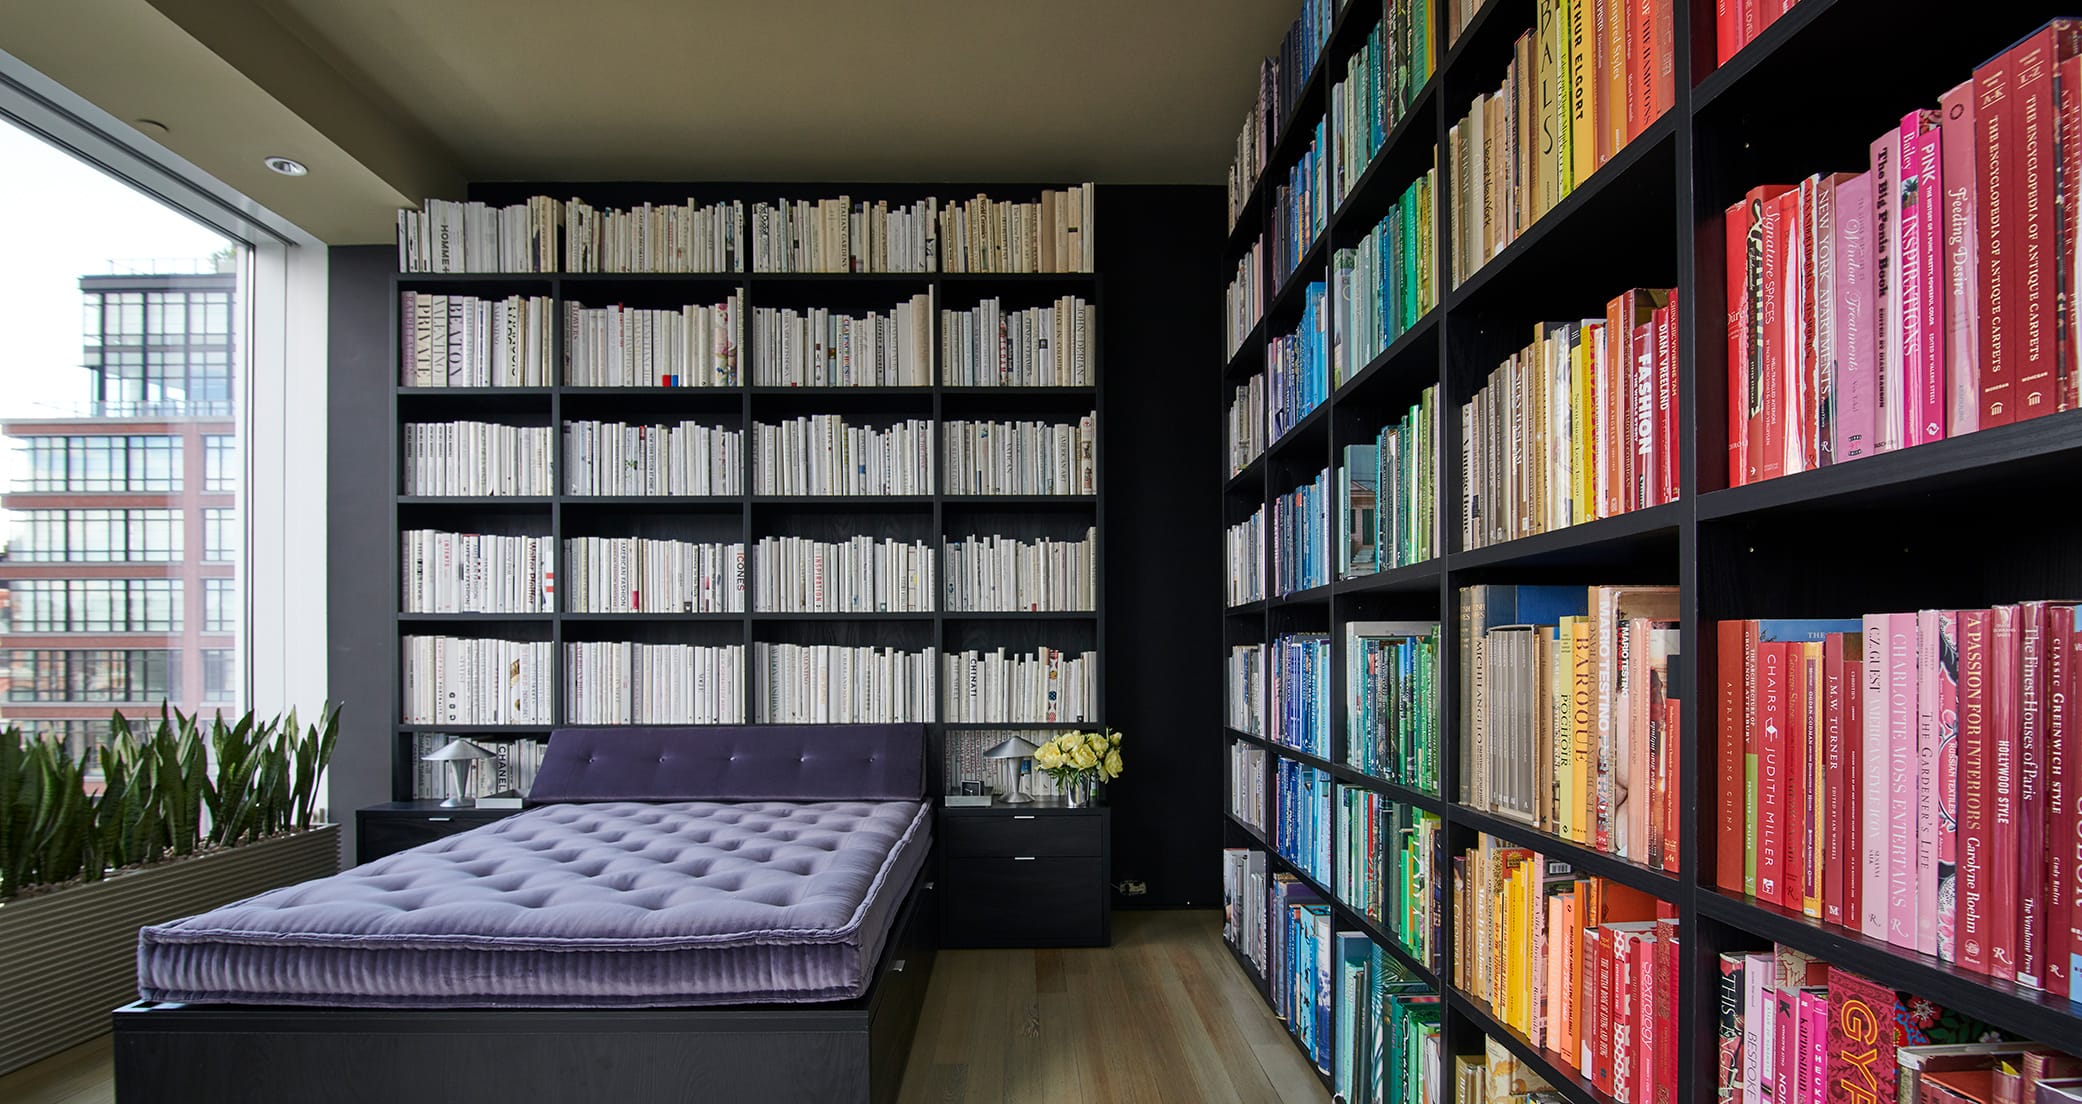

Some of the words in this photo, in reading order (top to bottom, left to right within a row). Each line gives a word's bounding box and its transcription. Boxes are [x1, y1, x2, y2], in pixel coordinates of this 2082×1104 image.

[1575, 53, 1584, 121] ELGORT
[1610, 46, 1623, 80] Styles
[1989, 116, 1999, 143] THE
[2026, 95, 2037, 123] THE
[1879, 147, 1889, 179] The
[1902, 132, 1917, 171] Bailey
[1921, 143, 1936, 185] PINK
[2026, 124, 2038, 220] ENCYCLOPEDIA
[1819, 190, 1829, 229] NEW
[1877, 180, 1889, 209] Big
[1990, 144, 2000, 238] ENCYCLOPEDIA
[1879, 210, 1889, 254] Penis
[1948, 187, 1967, 245] Feeding
[2028, 224, 2038, 239] OF
[1820, 234, 1830, 282] YORK
[1844, 219, 1861, 284] Window
[1991, 240, 2000, 254] OF
[1879, 256, 1889, 298] Book
[1903, 214, 1919, 357] INSPIRATIONS
[1953, 247, 1968, 297] Desire
[1991, 260, 2001, 314] ANTIQUE
[2028, 244, 2039, 300] ANTIQUE
[1076, 309, 1085, 332] JOHN
[1765, 280, 1775, 325] SPACES
[416, 304, 432, 379] PRIVATE
[433, 299, 446, 374] VALENTINO
[449, 302, 463, 378] BEATON
[1659, 324, 1669, 356] DIANA
[1820, 288, 1831, 394] APARTMENTS
[1845, 291, 1860, 371] Treatments
[1992, 317, 2001, 372] CARPETS
[2029, 303, 2039, 361] CARPETS
[1076, 340, 1086, 376] DERIAN
[1638, 352, 1652, 455] FASHION
[1660, 359, 1669, 410] VREELAND
[1599, 601, 1610, 657] MARIO
[1621, 627, 1630, 658] MARIO
[1967, 616, 1982, 628] A
[2023, 625, 2039, 652] The
[1621, 659, 1630, 698] TESTINO
[1767, 654, 1776, 712] CHAIRS
[1869, 651, 1881, 693] GUEST
[1892, 633, 1908, 739] CHARLOTTE
[1967, 632, 1982, 699] PASSION
[2023, 656, 2039, 695] Finest
[2053, 638, 2061, 687] CLASSIC
[1574, 637, 1589, 764] BAROQUE
[1598, 660, 1610, 731] TESTINO
[1967, 704, 1982, 735] FOR
[1830, 717, 1838, 769] TURNER
[2023, 701, 2038, 749] Houses
[2053, 692, 2065, 775] GREENWICH
[498, 745, 507, 791] CHANEL
[1765, 747, 1775, 805] JUDITH
[1892, 745, 1908, 793] MOSS
[1948, 742, 1957, 776] RUSSIAN
[1997, 740, 2010, 794] HOLLYWOOD
[2023, 752, 2039, 767] of
[1948, 779, 1957, 815] TEXTILES
[1967, 740, 1982, 830] INTERIORS
[2023, 770, 2038, 801] Paris
[2052, 780, 2062, 815] STYLE
[1997, 797, 2010, 825] STYLE
[1765, 812, 1774, 866] MILLER
[1892, 799, 1908, 907] ENTERTAINS
[1921, 840, 1932, 870] LIFE
[1963, 837, 1981, 888] Carolyne
[2052, 857, 2062, 878] Cindy
[1967, 891, 1982, 933] Roehm
[2024, 898, 2034, 912] The
[2024, 914, 2035, 952] Vendome
[1641, 961, 1653, 1051] Sextrology
[1720, 972, 1737, 1015] THIS
[1747, 1031, 1758, 1098] BESPOKE
